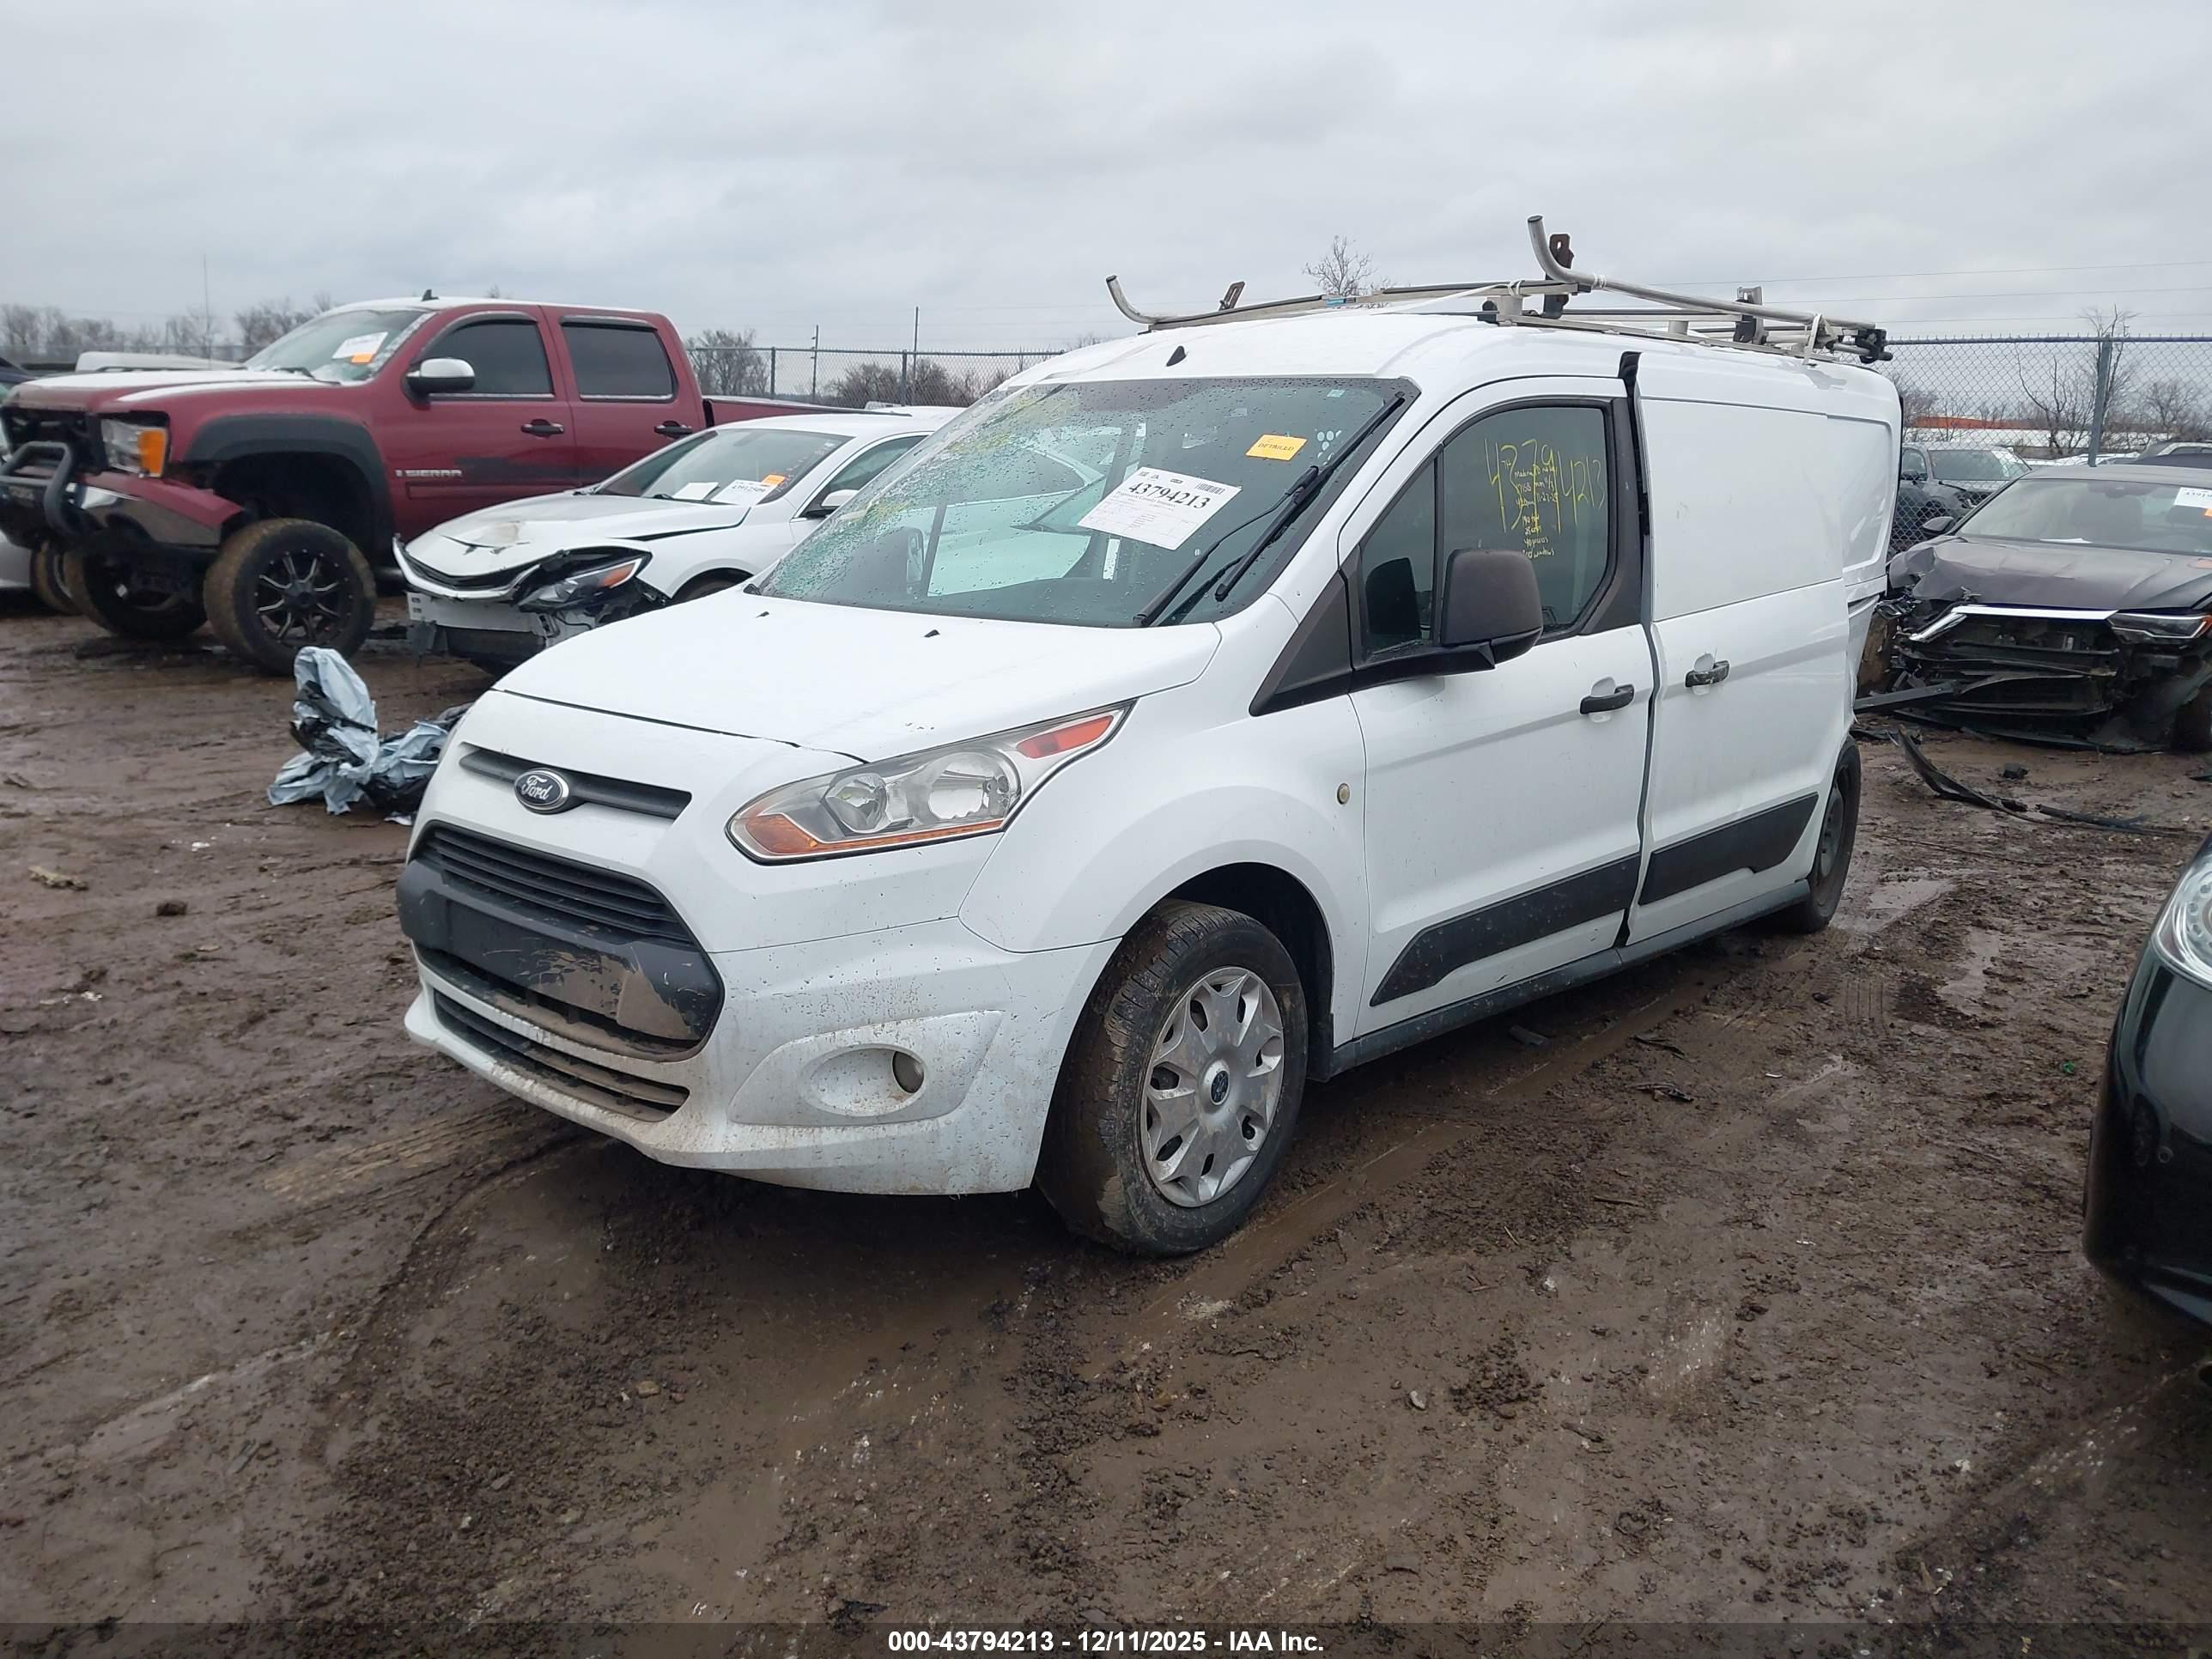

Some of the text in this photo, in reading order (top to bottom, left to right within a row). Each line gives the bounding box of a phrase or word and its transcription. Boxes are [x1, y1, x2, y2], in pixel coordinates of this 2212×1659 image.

[404, 469, 462, 477] SIERRA
[1128, 482, 1212, 509] 43794213
[1485, 439, 1606, 535] 43794213
[521, 775, 554, 800] Ford
